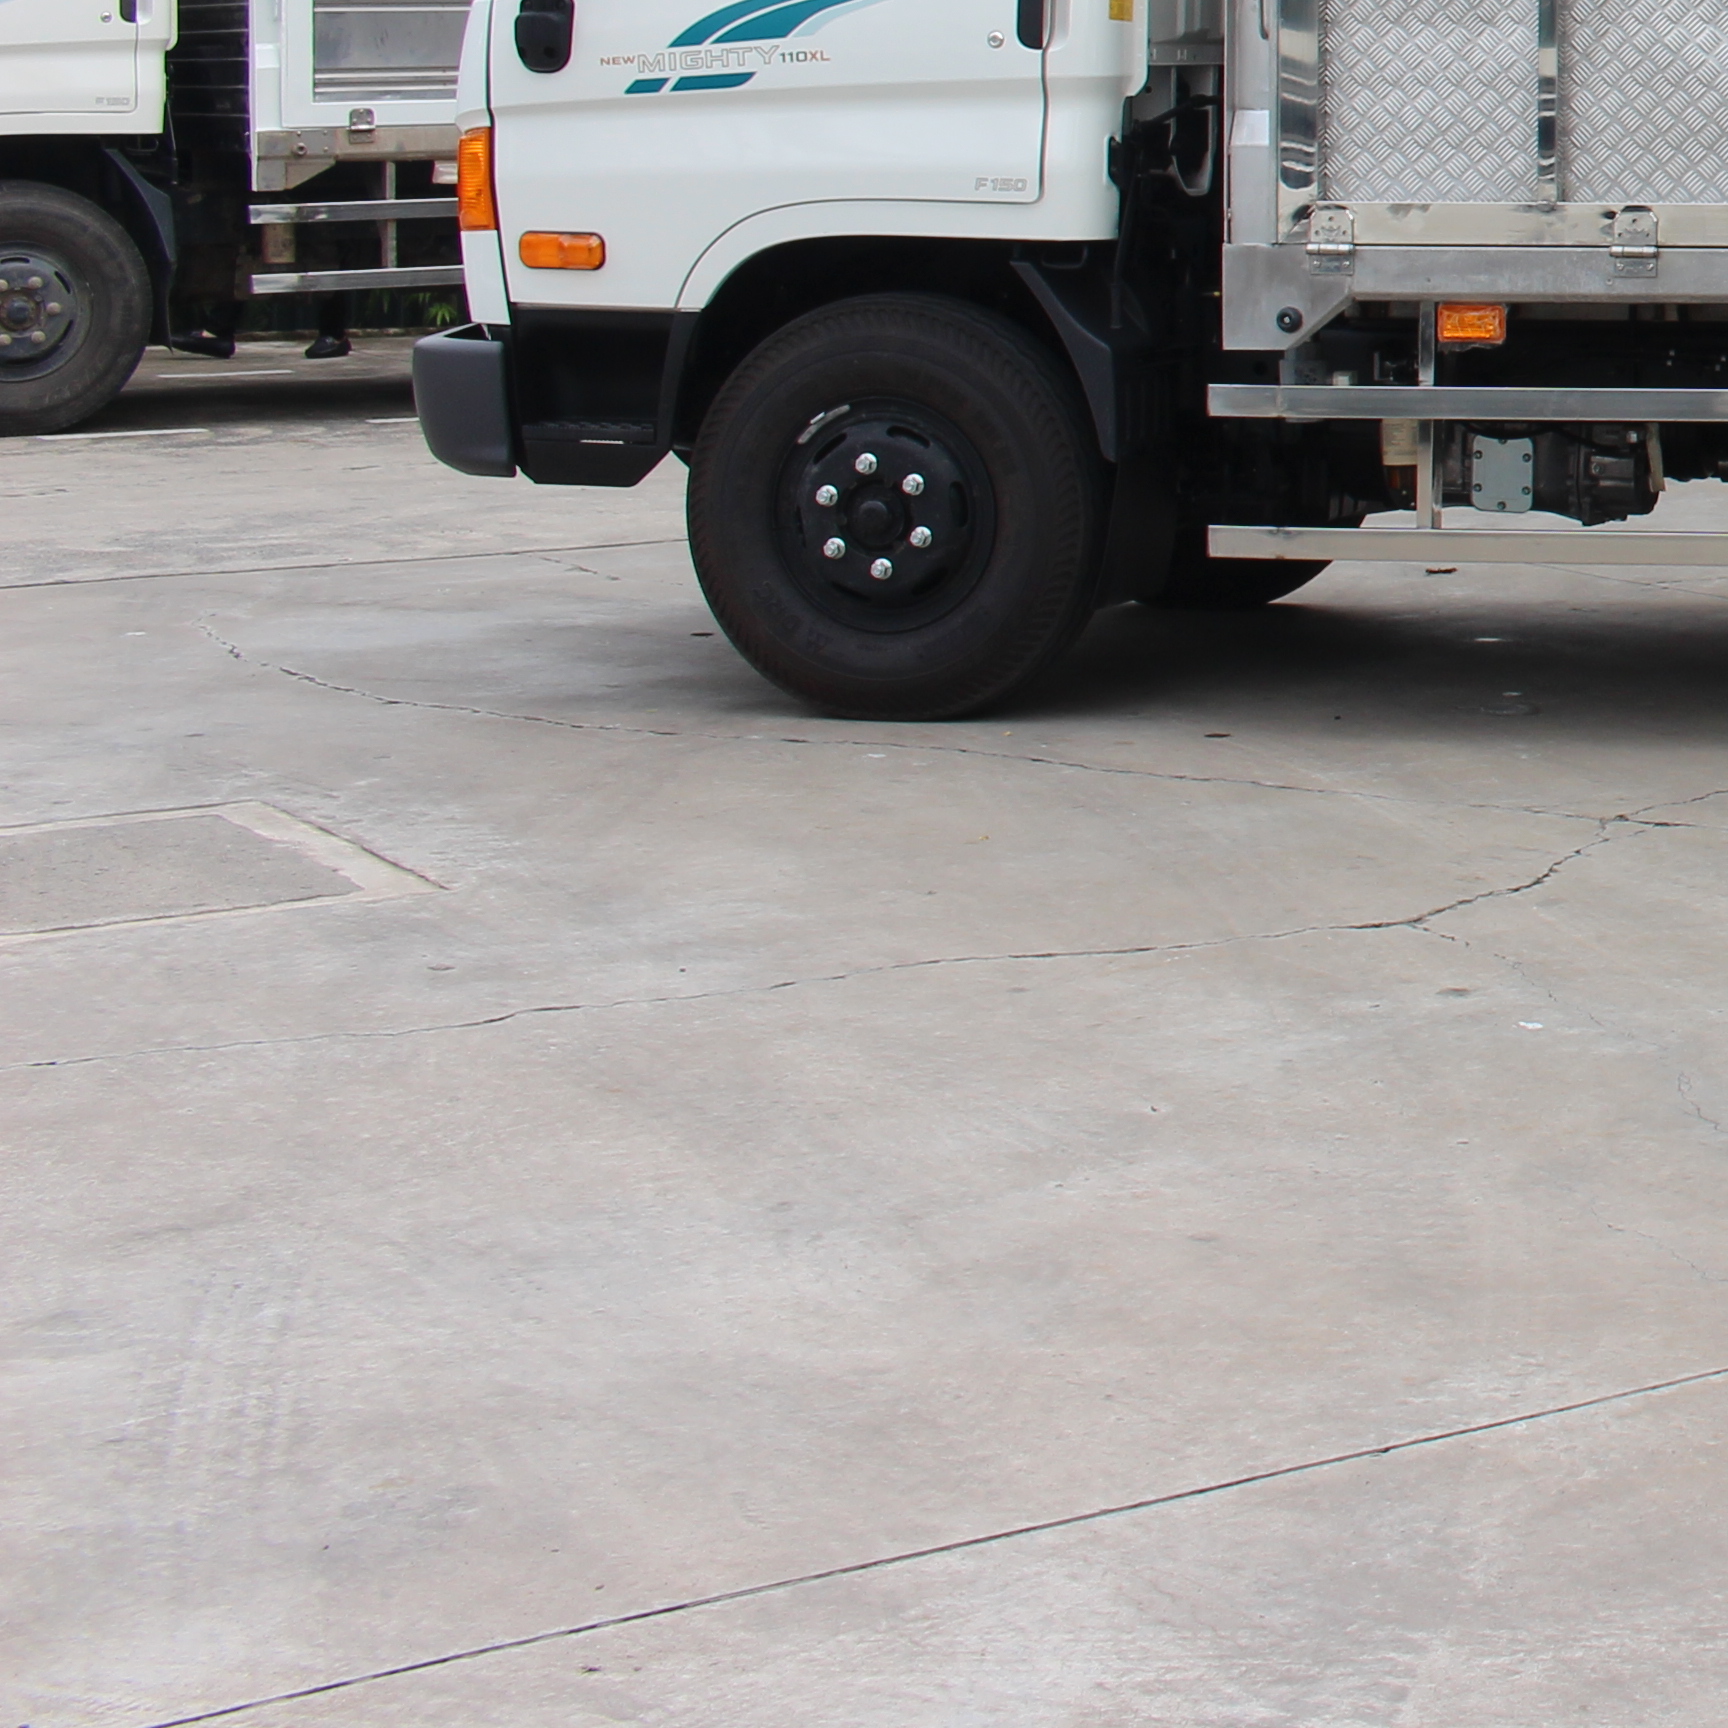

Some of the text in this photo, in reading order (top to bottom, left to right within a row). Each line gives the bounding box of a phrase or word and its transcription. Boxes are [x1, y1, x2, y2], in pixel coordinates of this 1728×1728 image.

[600, 45, 831, 73] NEW MIGHTY 110XL
